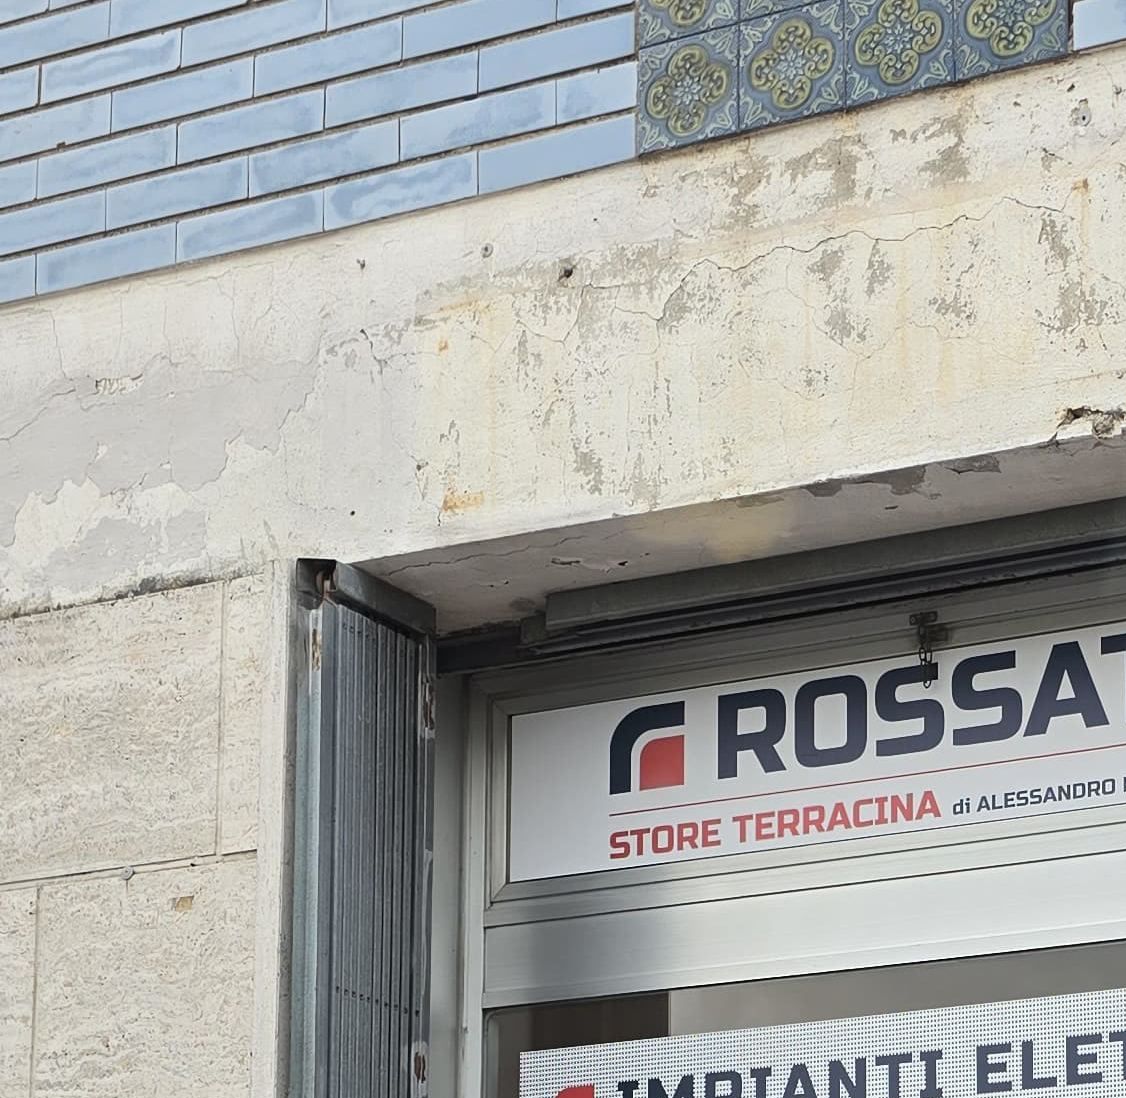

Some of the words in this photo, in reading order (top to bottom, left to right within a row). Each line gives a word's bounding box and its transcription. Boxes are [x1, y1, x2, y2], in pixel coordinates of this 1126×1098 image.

[609, 818, 722, 860] STORE
[732, 790, 942, 843] TERRACINA
[952, 797, 972, 816] di
[976, 778, 1117, 813] ALESSANDRO
